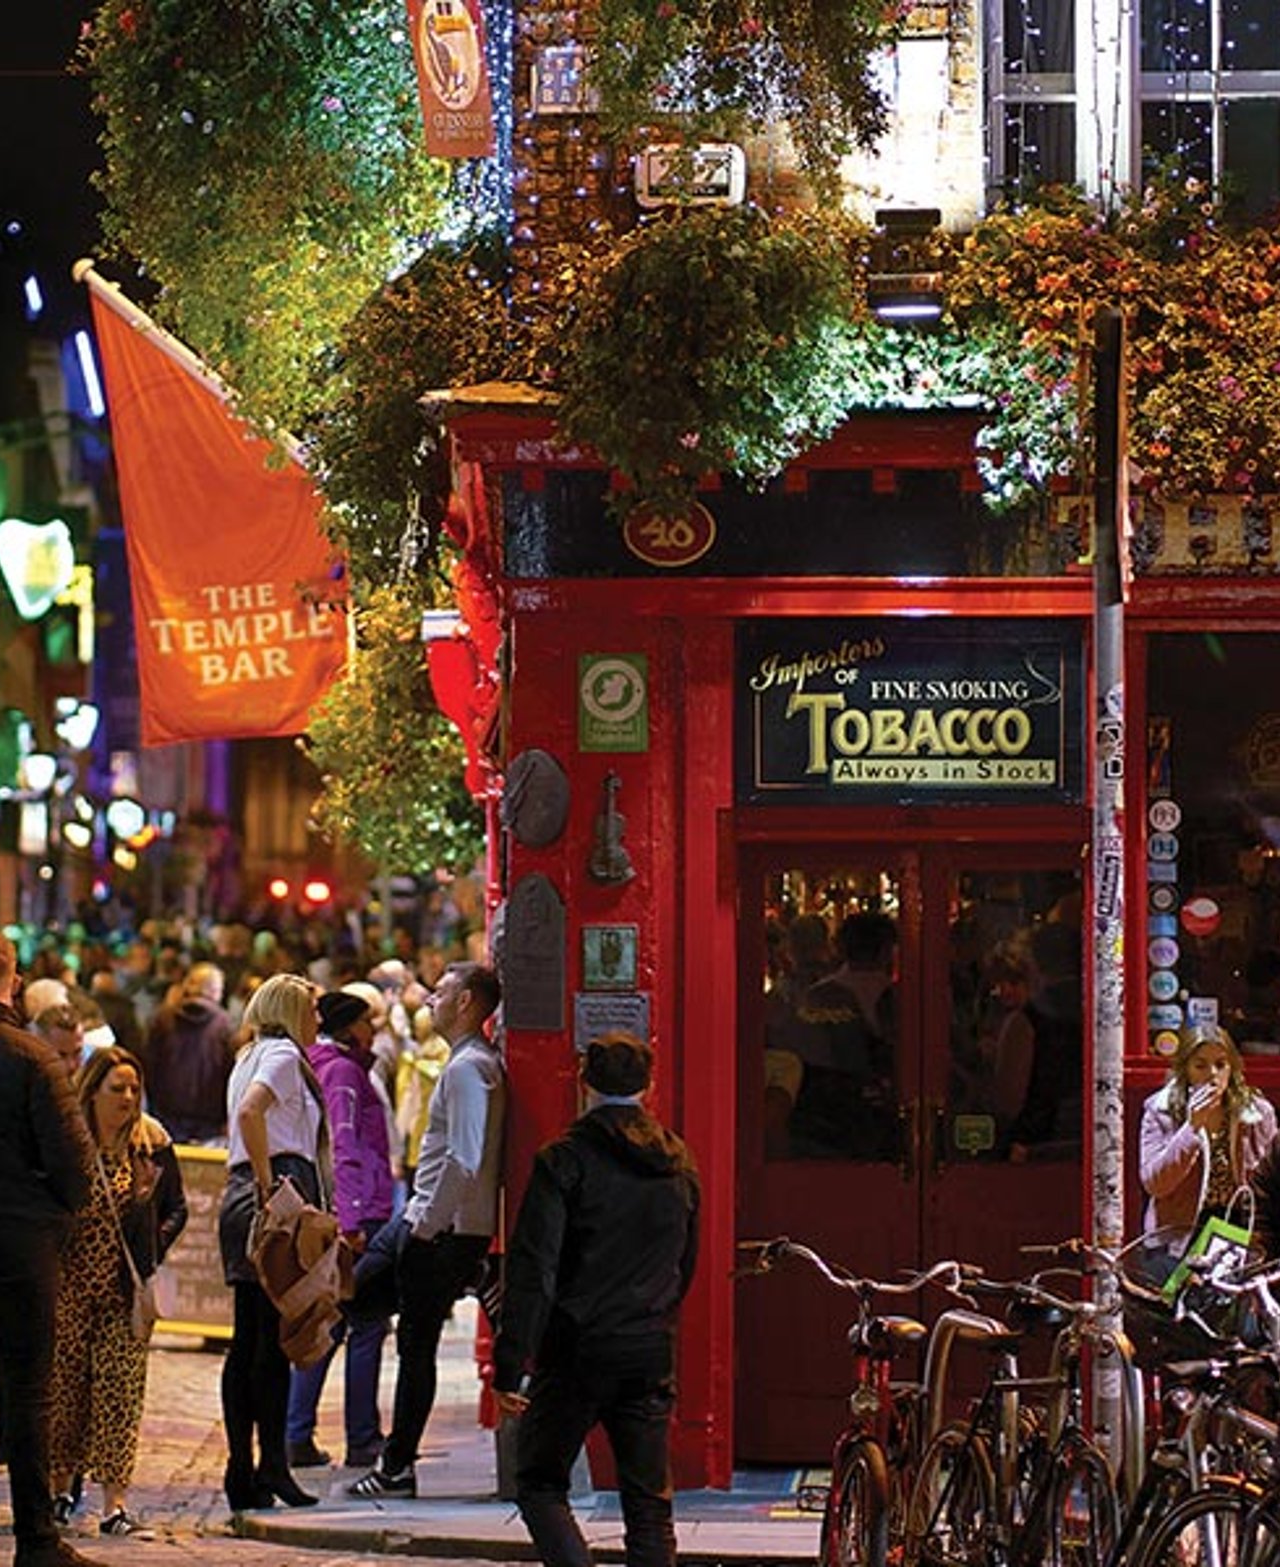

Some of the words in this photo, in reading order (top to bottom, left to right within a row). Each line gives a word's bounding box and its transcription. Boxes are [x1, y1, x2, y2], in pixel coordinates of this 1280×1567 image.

[201, 583, 278, 613] THE
[149, 607, 334, 654] TEMPLE
[199, 647, 294, 685] BAR
[749, 636, 886, 693] Importers
[834, 668, 859, 685] OF
[871, 680, 923, 700] FINE
[925, 680, 1029, 701] SMOKING
[785, 692, 1032, 774] TOBACCO
[836, 760, 929, 782] Always
[942, 761, 966, 780] in
[976, 760, 1052, 780] Stock
